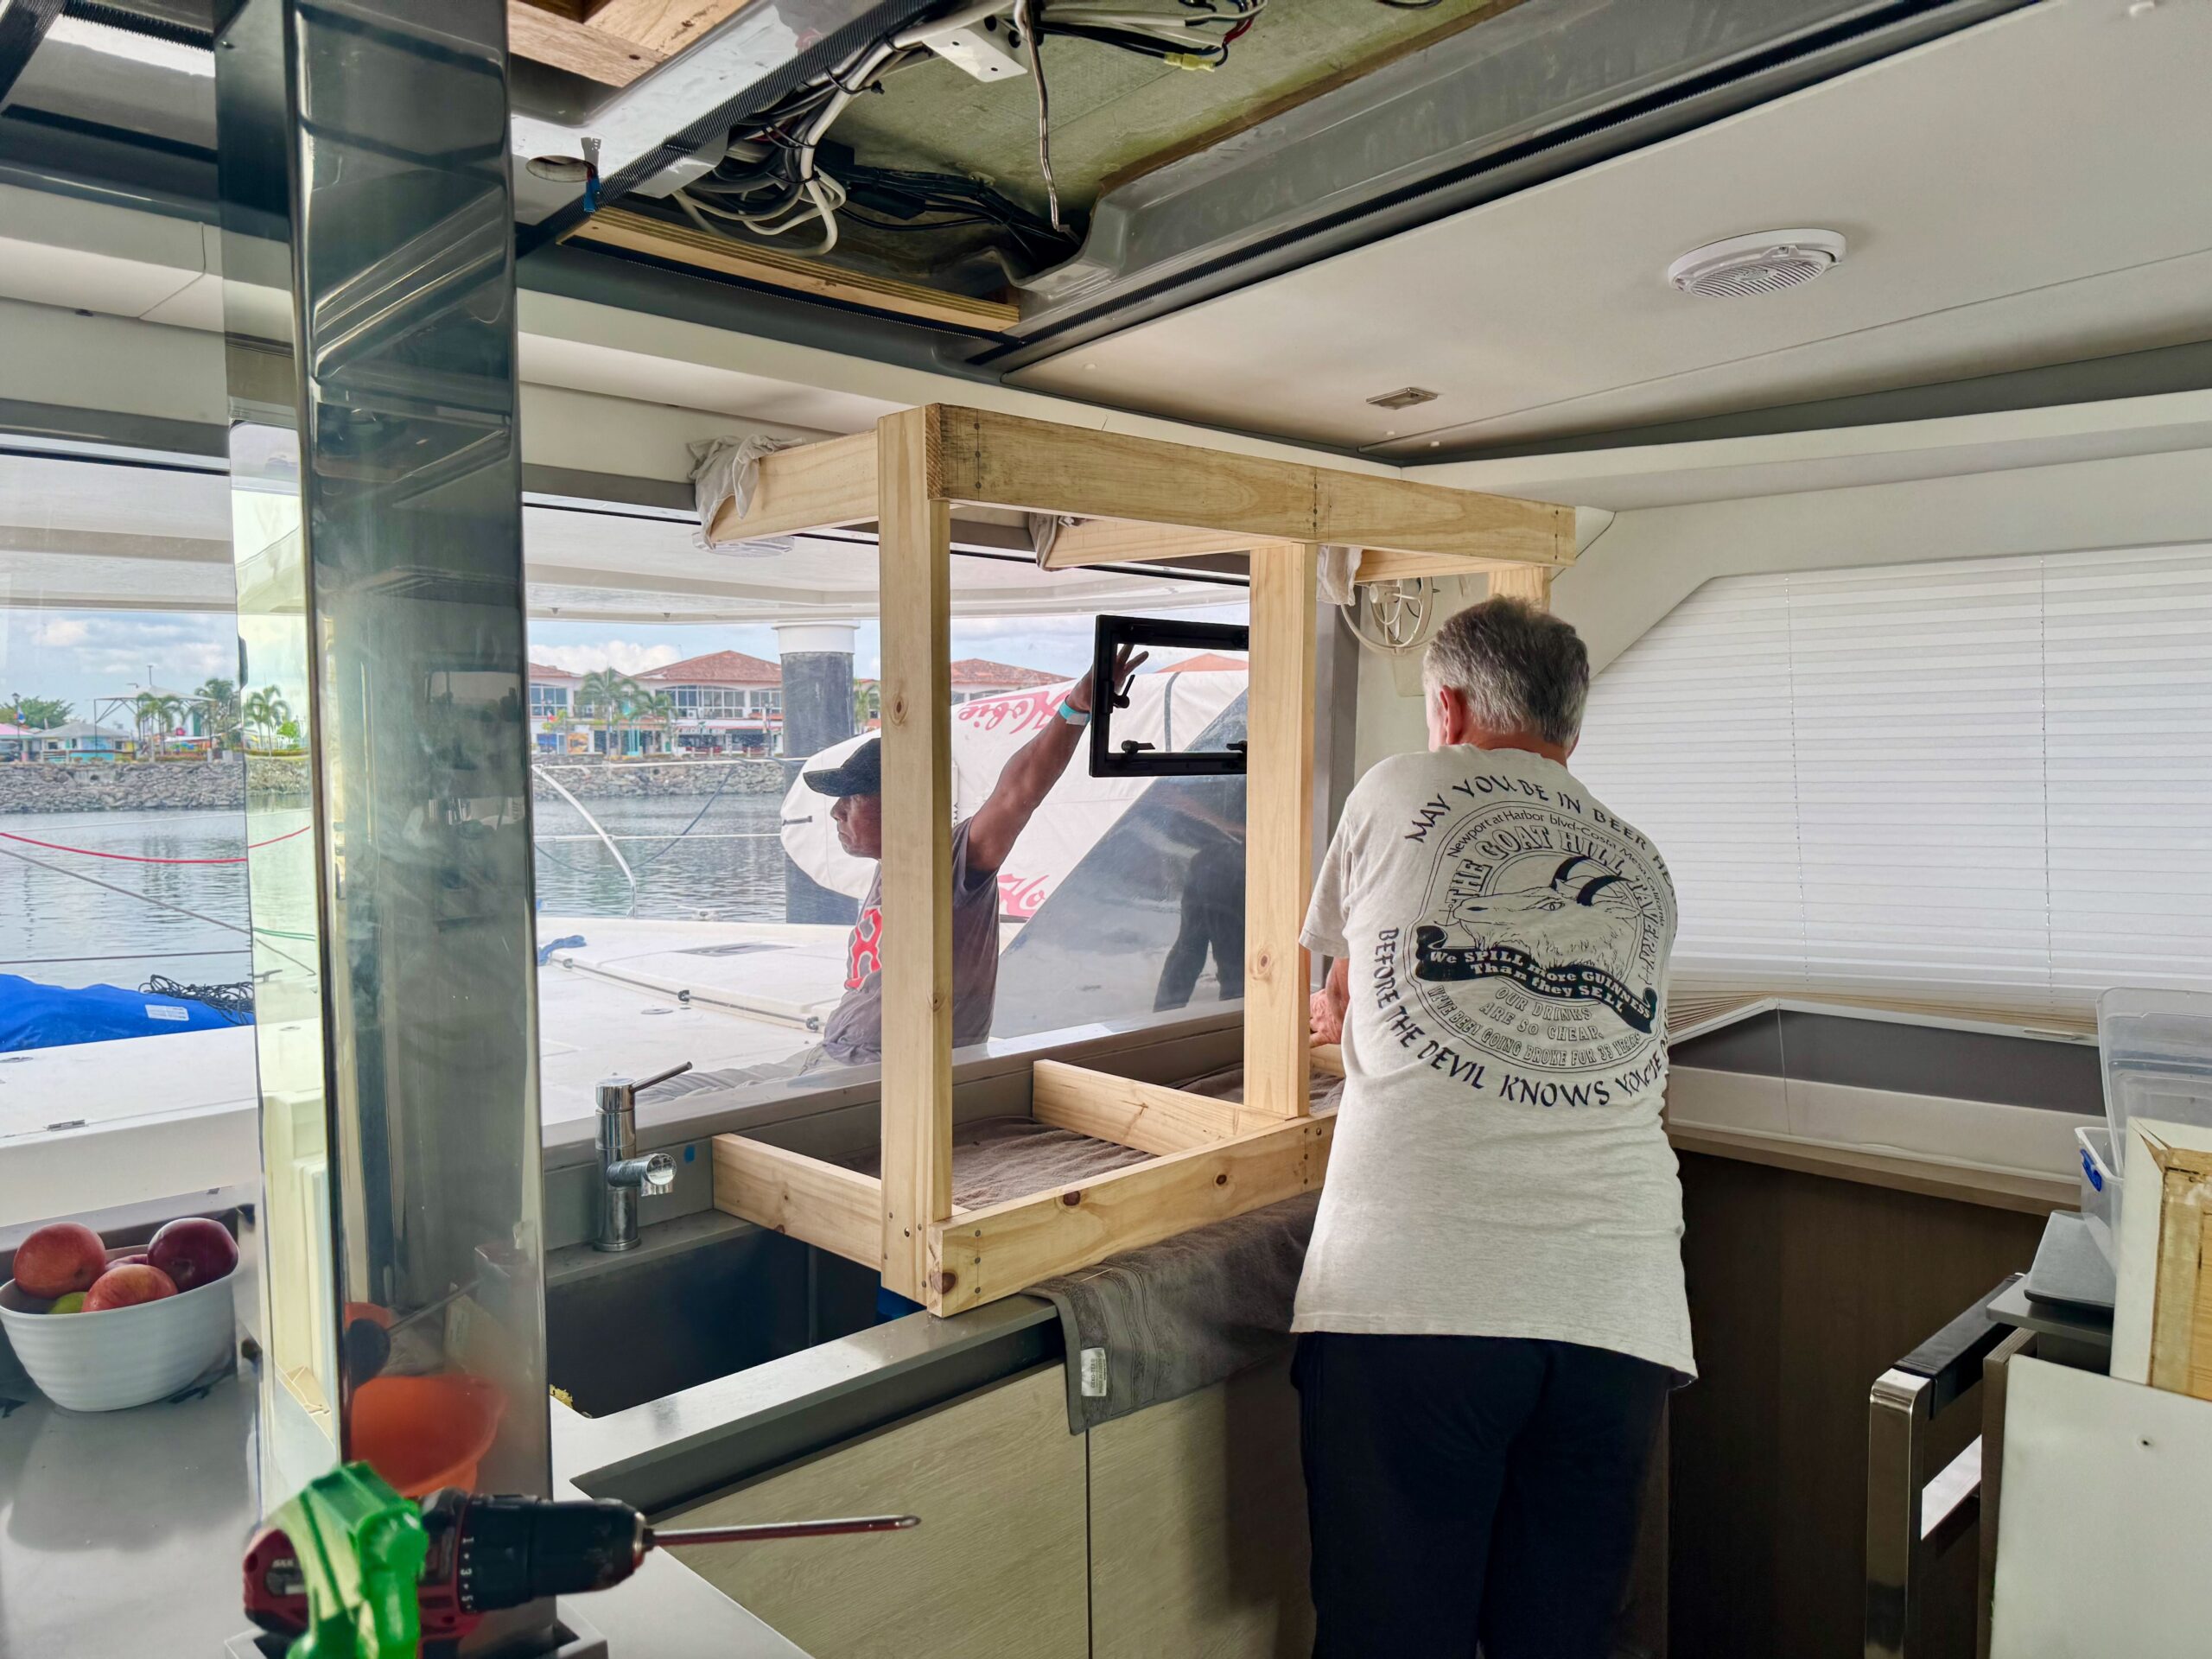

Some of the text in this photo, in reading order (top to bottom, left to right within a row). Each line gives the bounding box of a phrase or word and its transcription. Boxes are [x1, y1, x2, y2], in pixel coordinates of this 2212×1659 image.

[1404, 793, 1451, 843] MAY
[1452, 775, 1517, 798] YOU
[1517, 779, 1549, 801] BE
[1557, 791, 1581, 814] IN
[1592, 808, 1646, 850] BEER
[1446, 819, 1492, 858] Newport
[1492, 814, 1504, 824] at
[1503, 810, 1544, 822] Harbor
[1445, 824, 1659, 970] THE GOAT HILL TAVERN
[1373, 927, 1400, 1009] BEFORE
[1430, 950, 1650, 1020] We SPILL more GUINNESS
[1470, 963, 1623, 1013] Than they SELL
[1385, 1005, 1426, 1048] THE
[1479, 1002, 1516, 1026] ARE
[1517, 1019, 1539, 1035] SO
[1495, 987, 1592, 1021] OUR DRINKS
[1449, 1010, 1482, 1036] BEEN
[1481, 1028, 1522, 1056] GOING
[1523, 1045, 1567, 1066] BROKE
[1571, 1051, 1597, 1065] FOR
[1598, 1044, 1613, 1060] 33
[1417, 1039, 1485, 1090] DEVIL
[1499, 1073, 1610, 1107] KNOWS
